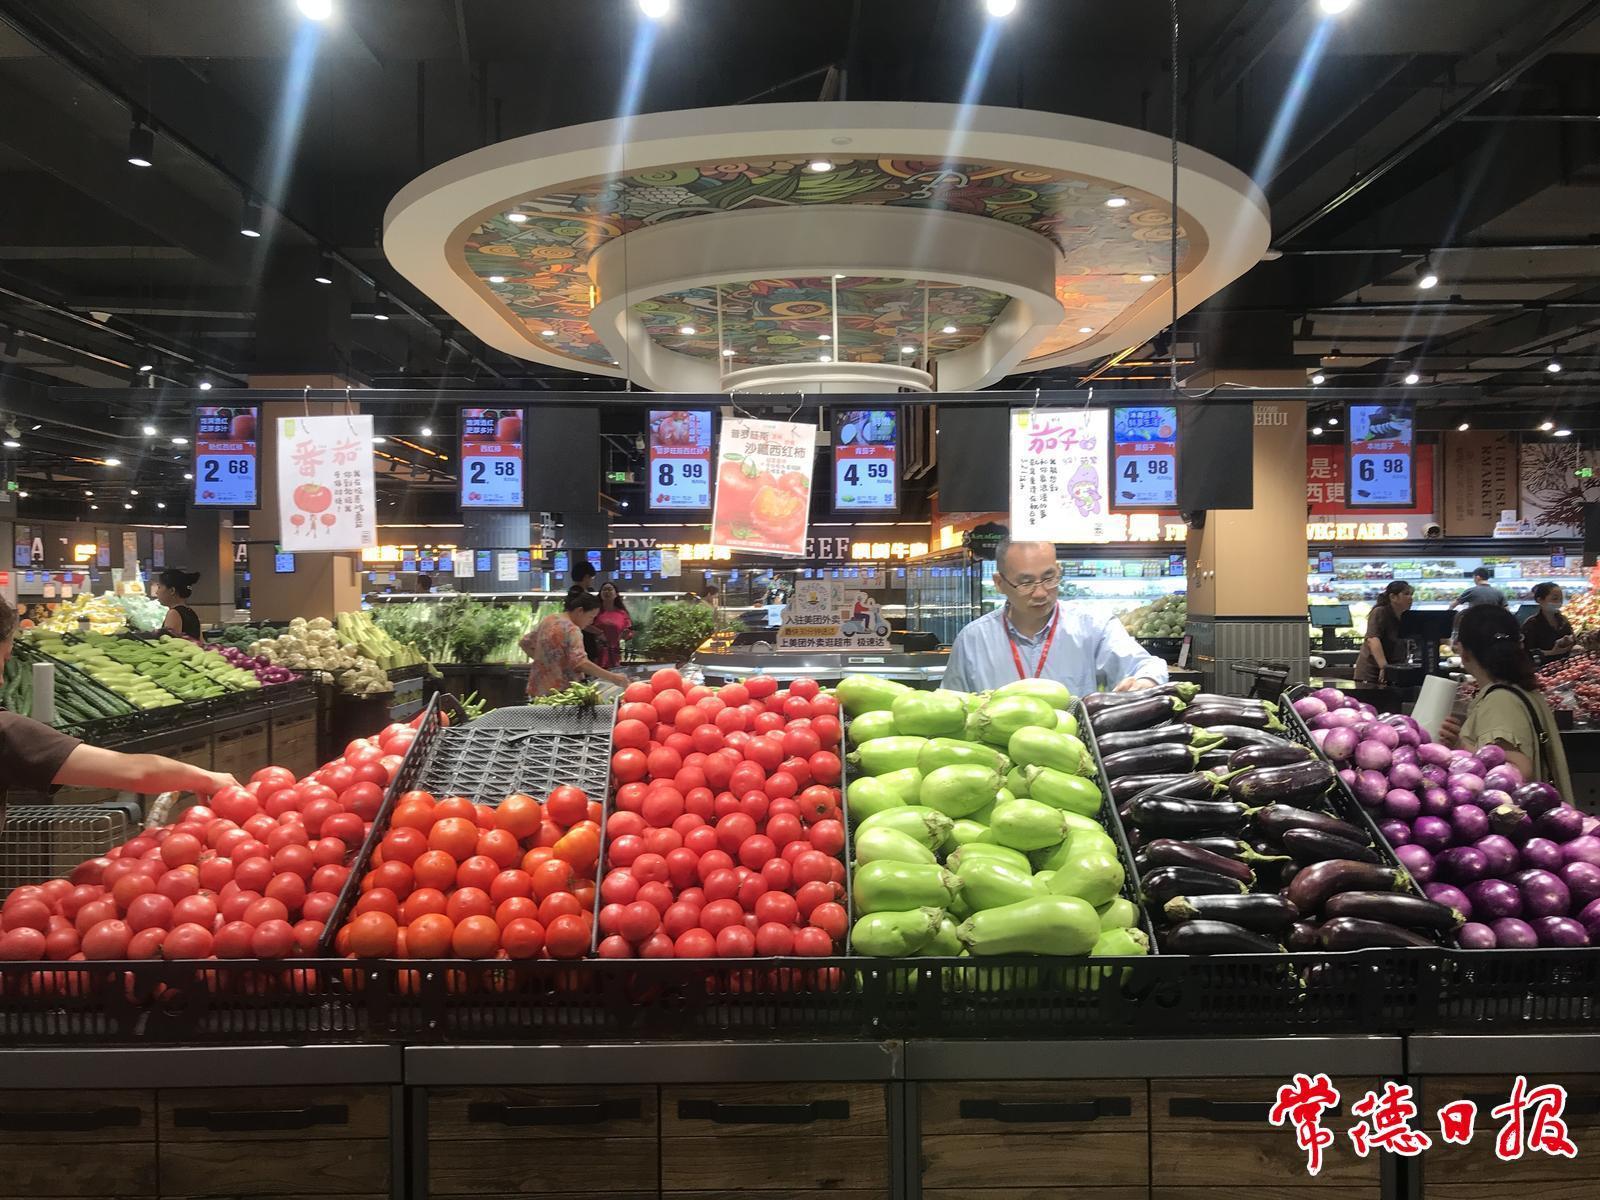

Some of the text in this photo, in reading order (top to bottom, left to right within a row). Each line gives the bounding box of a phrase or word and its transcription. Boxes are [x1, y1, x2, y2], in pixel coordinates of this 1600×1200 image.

[291, 438, 361, 477] 番茄
[229, 460, 248, 474] 68
[495, 461, 515, 476] 58
[682, 463, 702, 478] 99
[868, 463, 888, 478] 59
[1148, 460, 1168, 474] 98
[1383, 459, 1403, 473] 98
[1305, 522, 1409, 540] VEGETABLES
